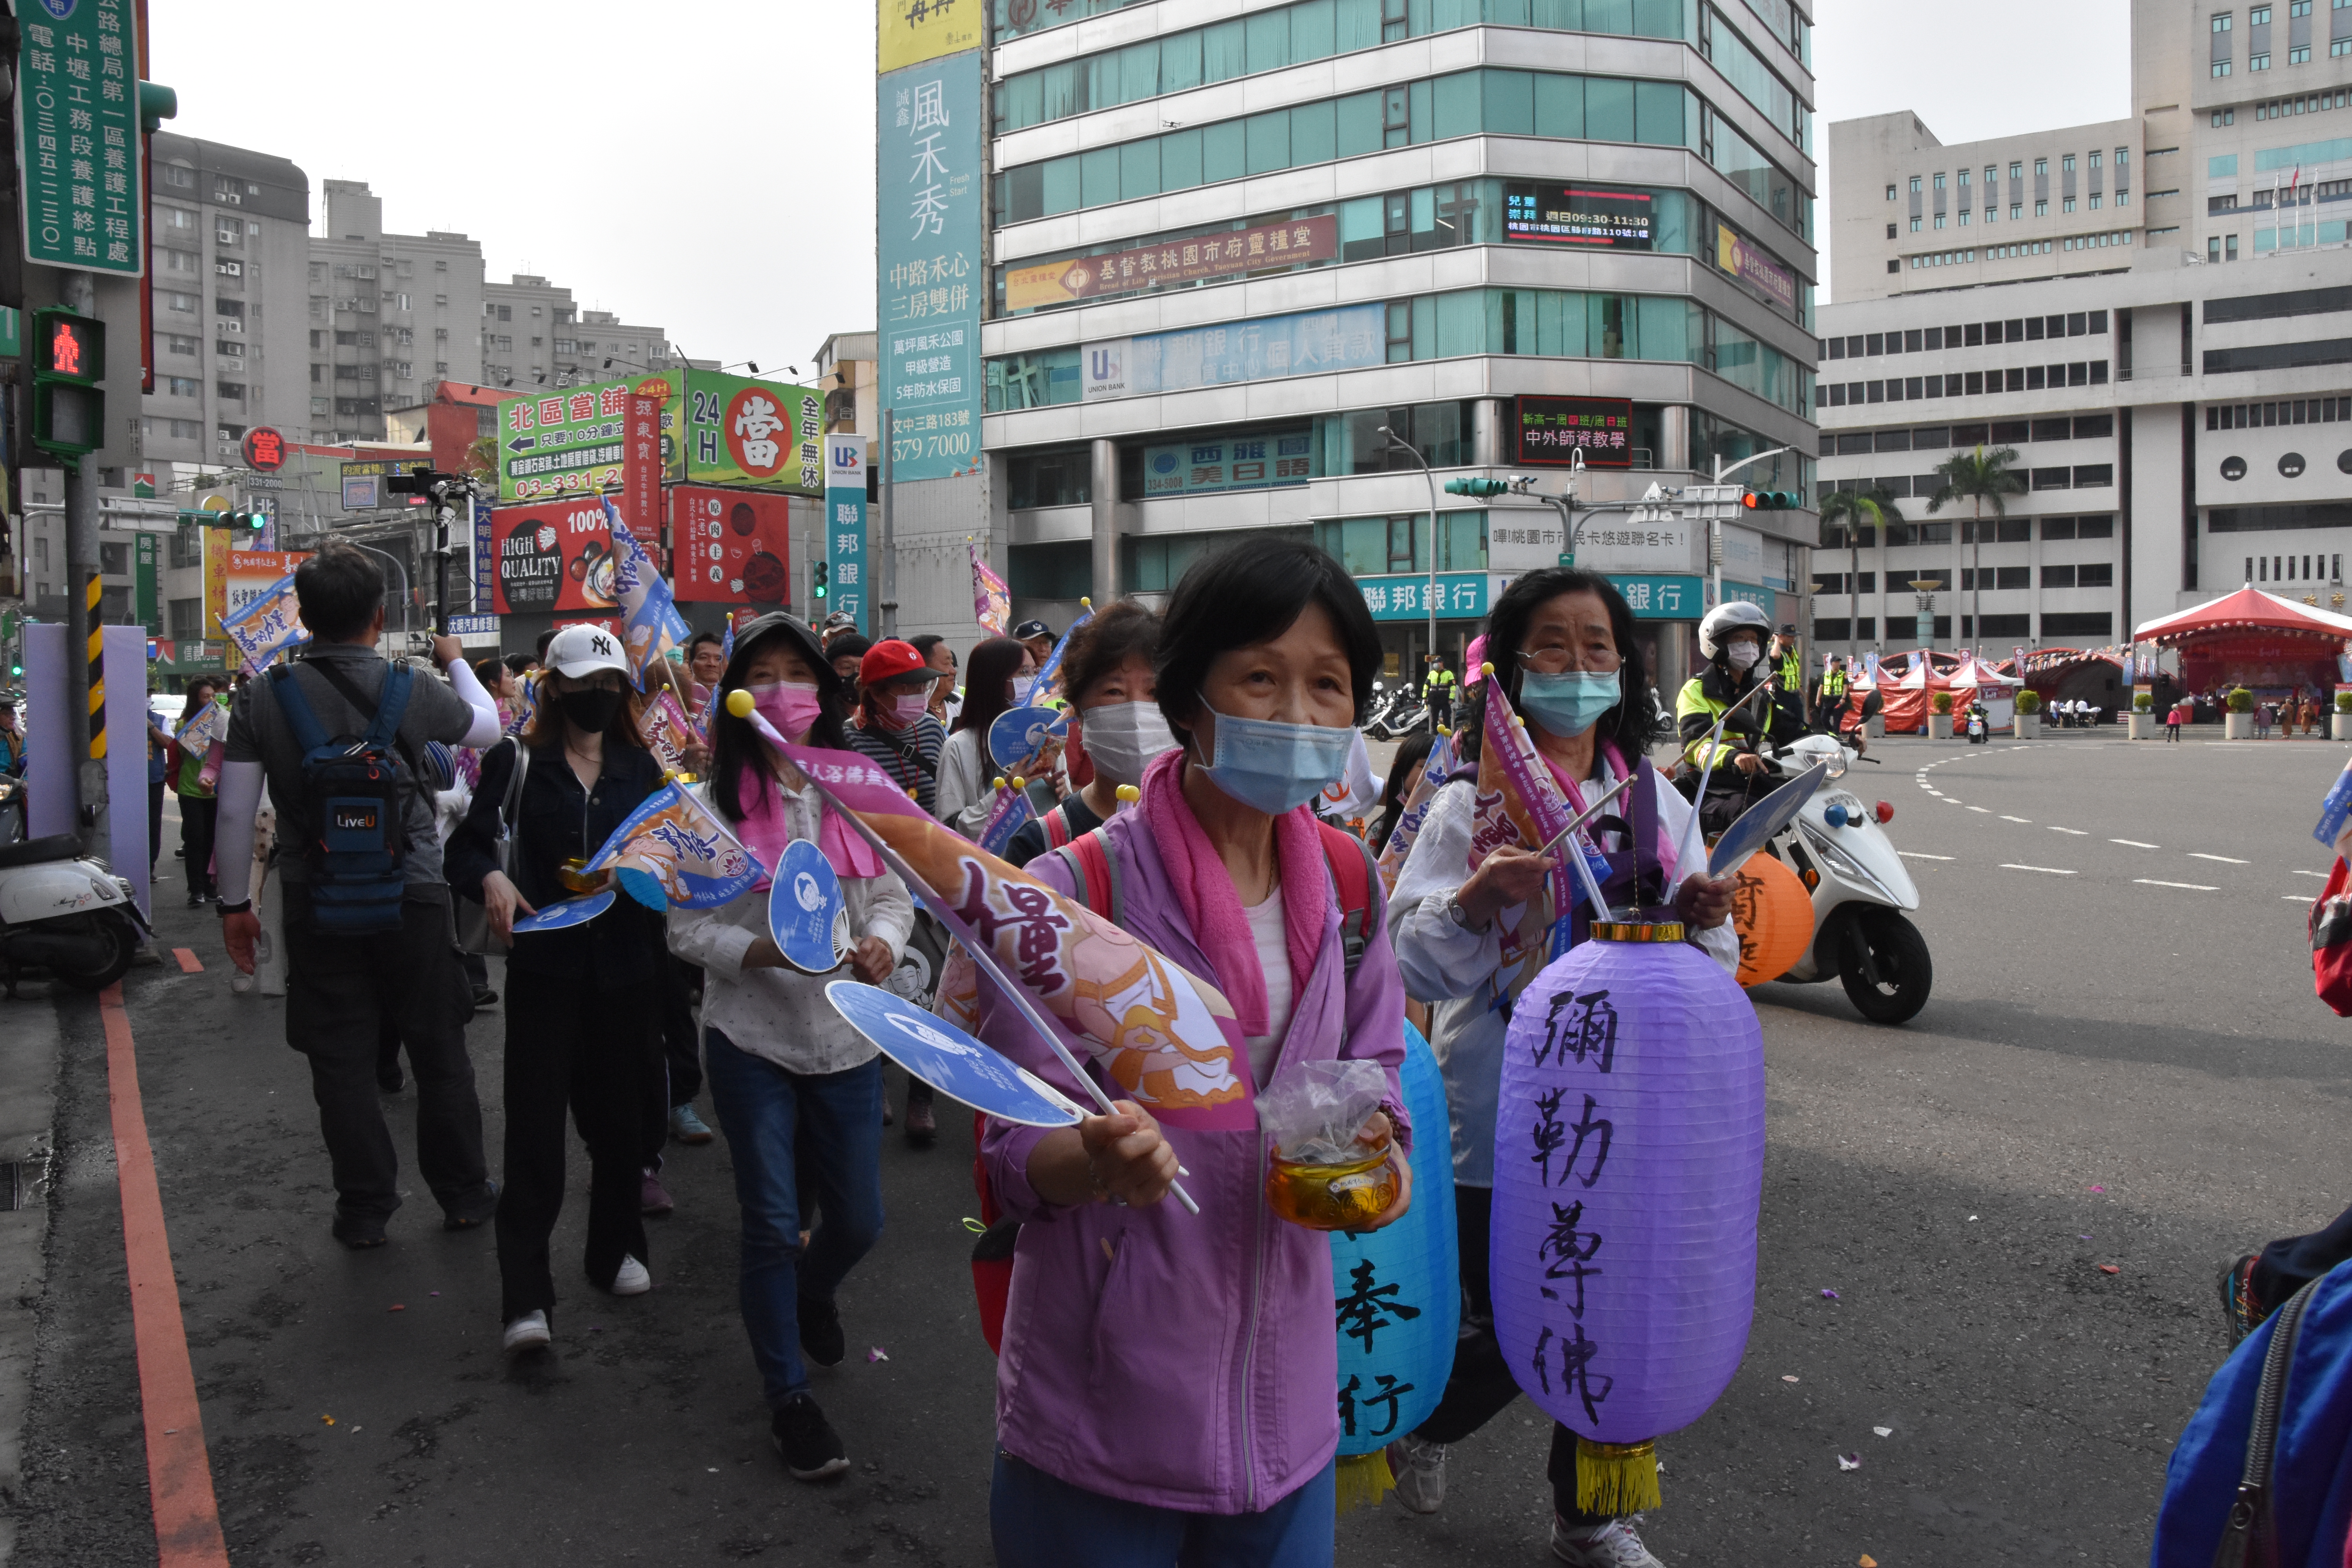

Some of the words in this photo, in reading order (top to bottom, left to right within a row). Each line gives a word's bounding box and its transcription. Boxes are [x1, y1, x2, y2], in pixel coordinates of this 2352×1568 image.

[896, 89, 909, 127] 誠鑫
[66, 33, 96, 257] 中壢工務段養護終點
[909, 80, 949, 241] 風禾秀
[950, 174, 969, 184] Fresh
[950, 186, 967, 196] Start
[1099, 225, 1311, 280] 基督教桃園市府靈糧堂
[1247, 257, 1261, 267] City
[1265, 250, 1310, 263] Government
[890, 252, 970, 290] 中路禾心
[890, 283, 969, 321] 三房雙併
[894, 330, 963, 355] 萬坪風禾公園
[906, 356, 951, 376] 甲級營造
[897, 377, 961, 400] 5年防水保固
[1108, 383, 1125, 391] BANK
[693, 390, 721, 426] 24
[892, 410, 970, 434] 文中三路183號
[735, 395, 784, 468] 當
[801, 395, 820, 488] 全年無休
[1526, 429, 1625, 449] 中外師資教學
[252, 432, 280, 464] 當
[699, 429, 718, 465] H
[892, 437, 922, 462] 379
[927, 432, 970, 458] 7000
[250, 477, 282, 488] 331-2000
[1190, 457, 1310, 485] 美日語
[140, 537, 152, 565] 房屋
[501, 536, 534, 556] HIGH
[710, 502, 721, 580] 原肉主義
[501, 556, 561, 579] QUALITY
[837, 503, 858, 615] 聯邦銀行
[1363, 583, 1477, 613] 聯邦銀行
[1612, 583, 1681, 611] 銀行
[337, 813, 376, 829] LiveU
[1530, 989, 1618, 1427] 彌勒尊佛
[1335, 1229, 1421, 1437] 奉行
